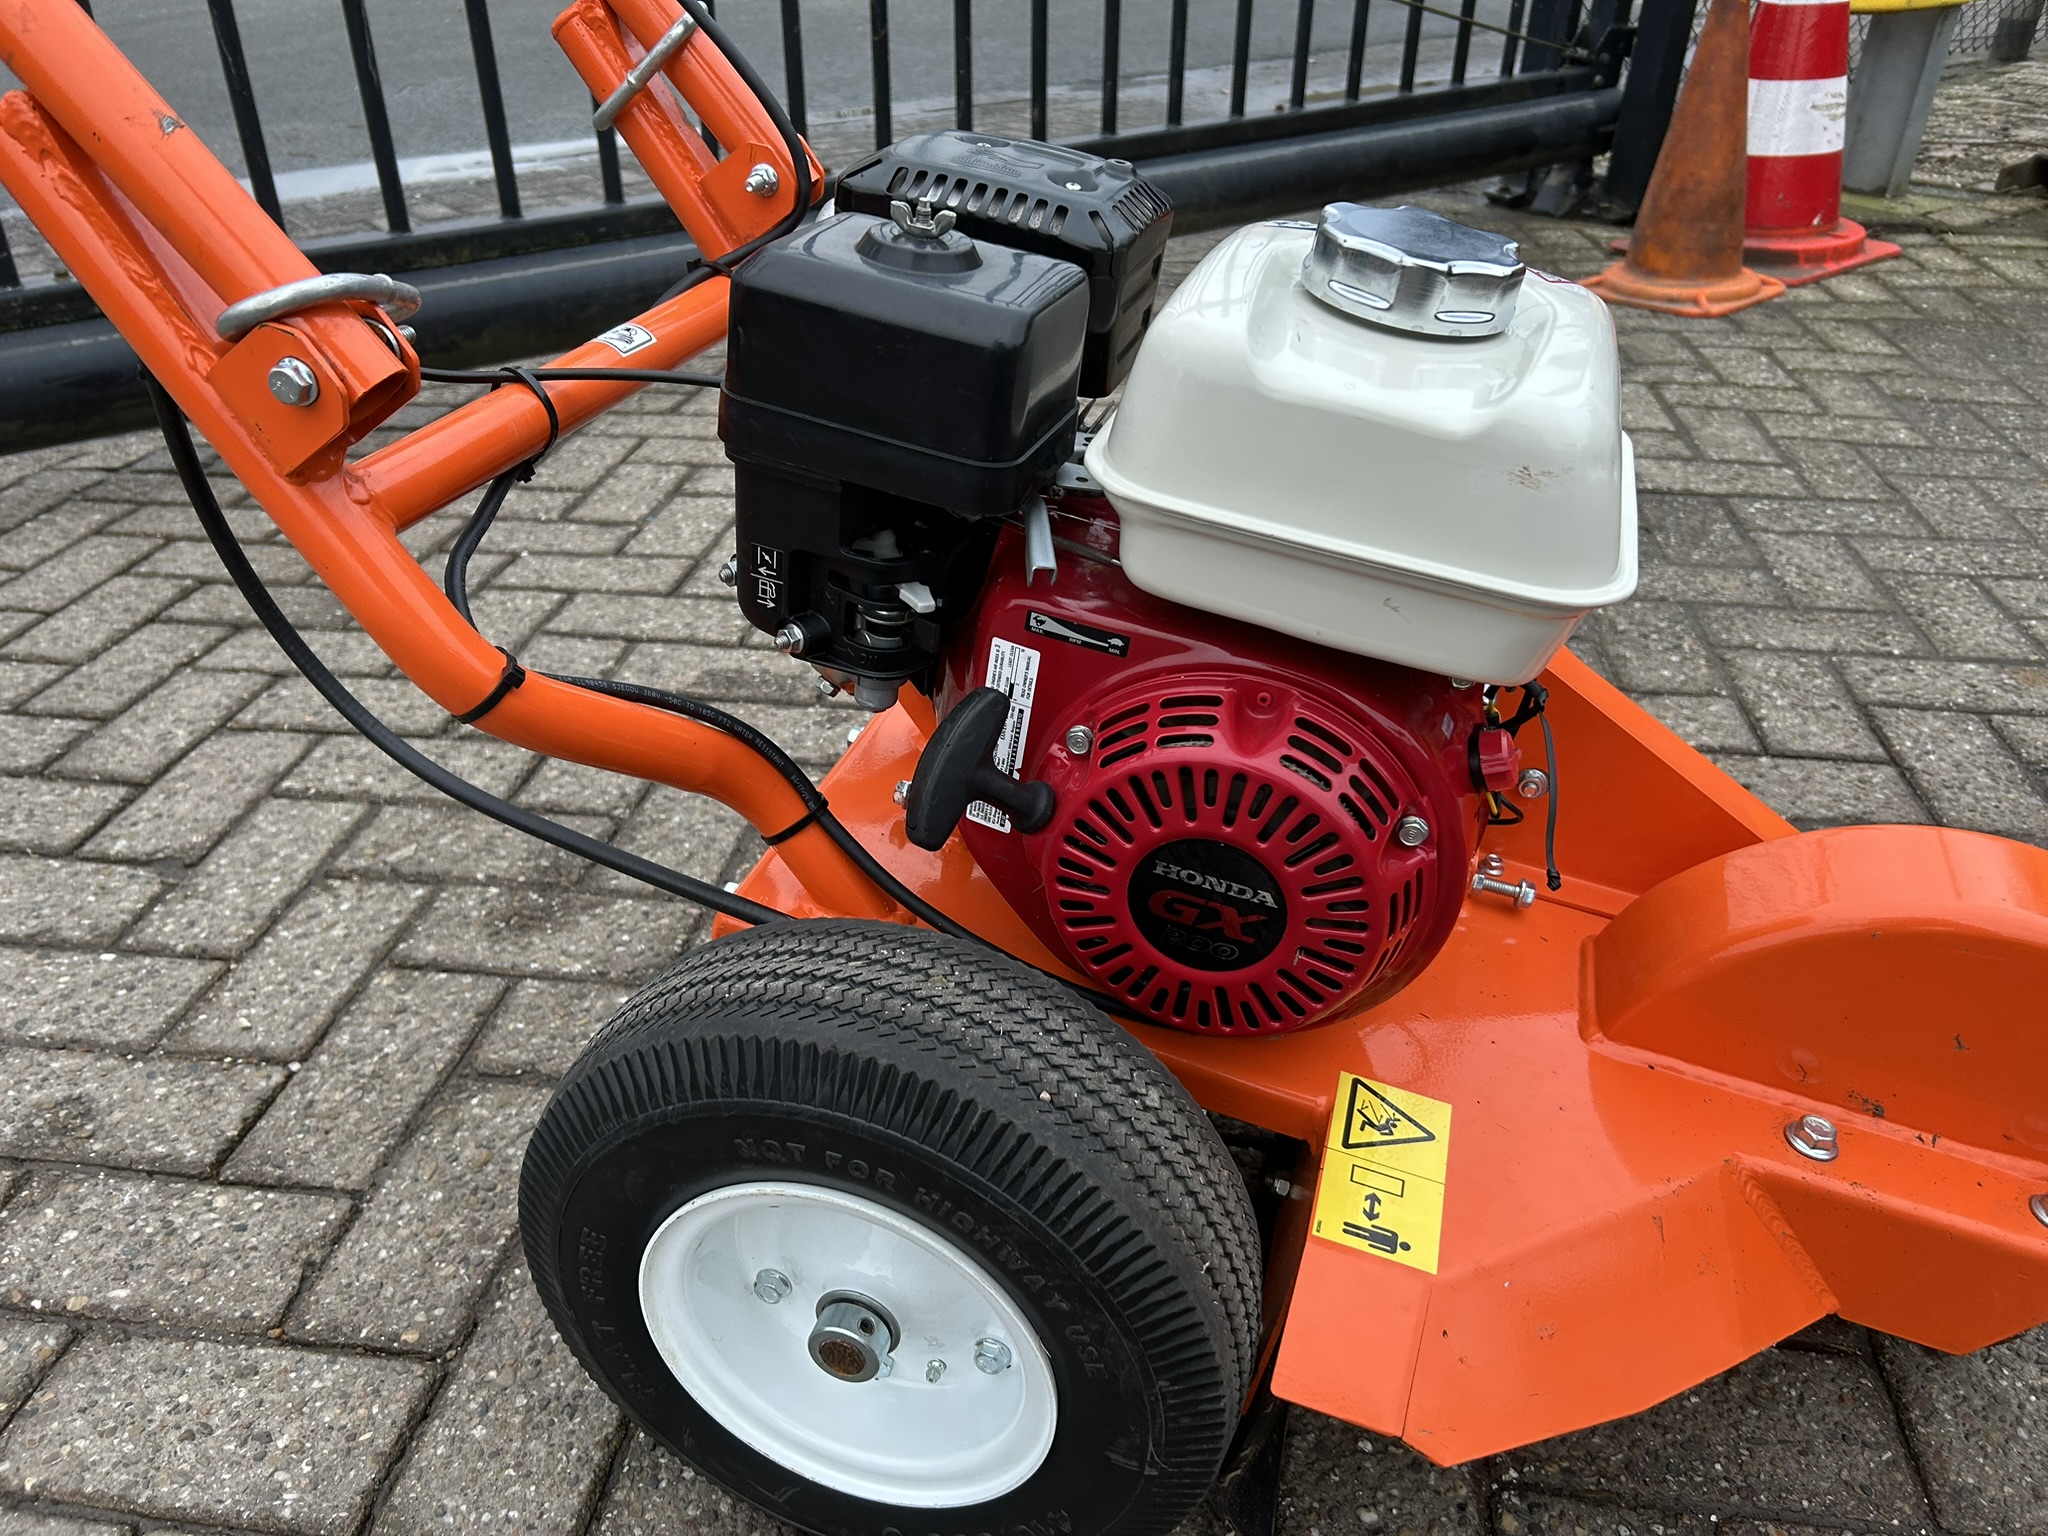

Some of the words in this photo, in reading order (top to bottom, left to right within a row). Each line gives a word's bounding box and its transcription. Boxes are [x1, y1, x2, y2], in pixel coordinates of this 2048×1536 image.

[686, 702, 695, 711] TO
[734, 724, 753, 740] WATER
[755, 738, 785, 767] RESISTANT
[1152, 860, 1278, 909] HONDA
[1148, 890, 1268, 944] GX
[1161, 925, 1238, 960] 200
[578, 1226, 608, 1304] FREE
[733, 1138, 806, 1163] NOT
[825, 1150, 896, 1192] FOR
[914, 1186, 1070, 1311] HIGHWAY
[1065, 1325, 1109, 1380] USE
